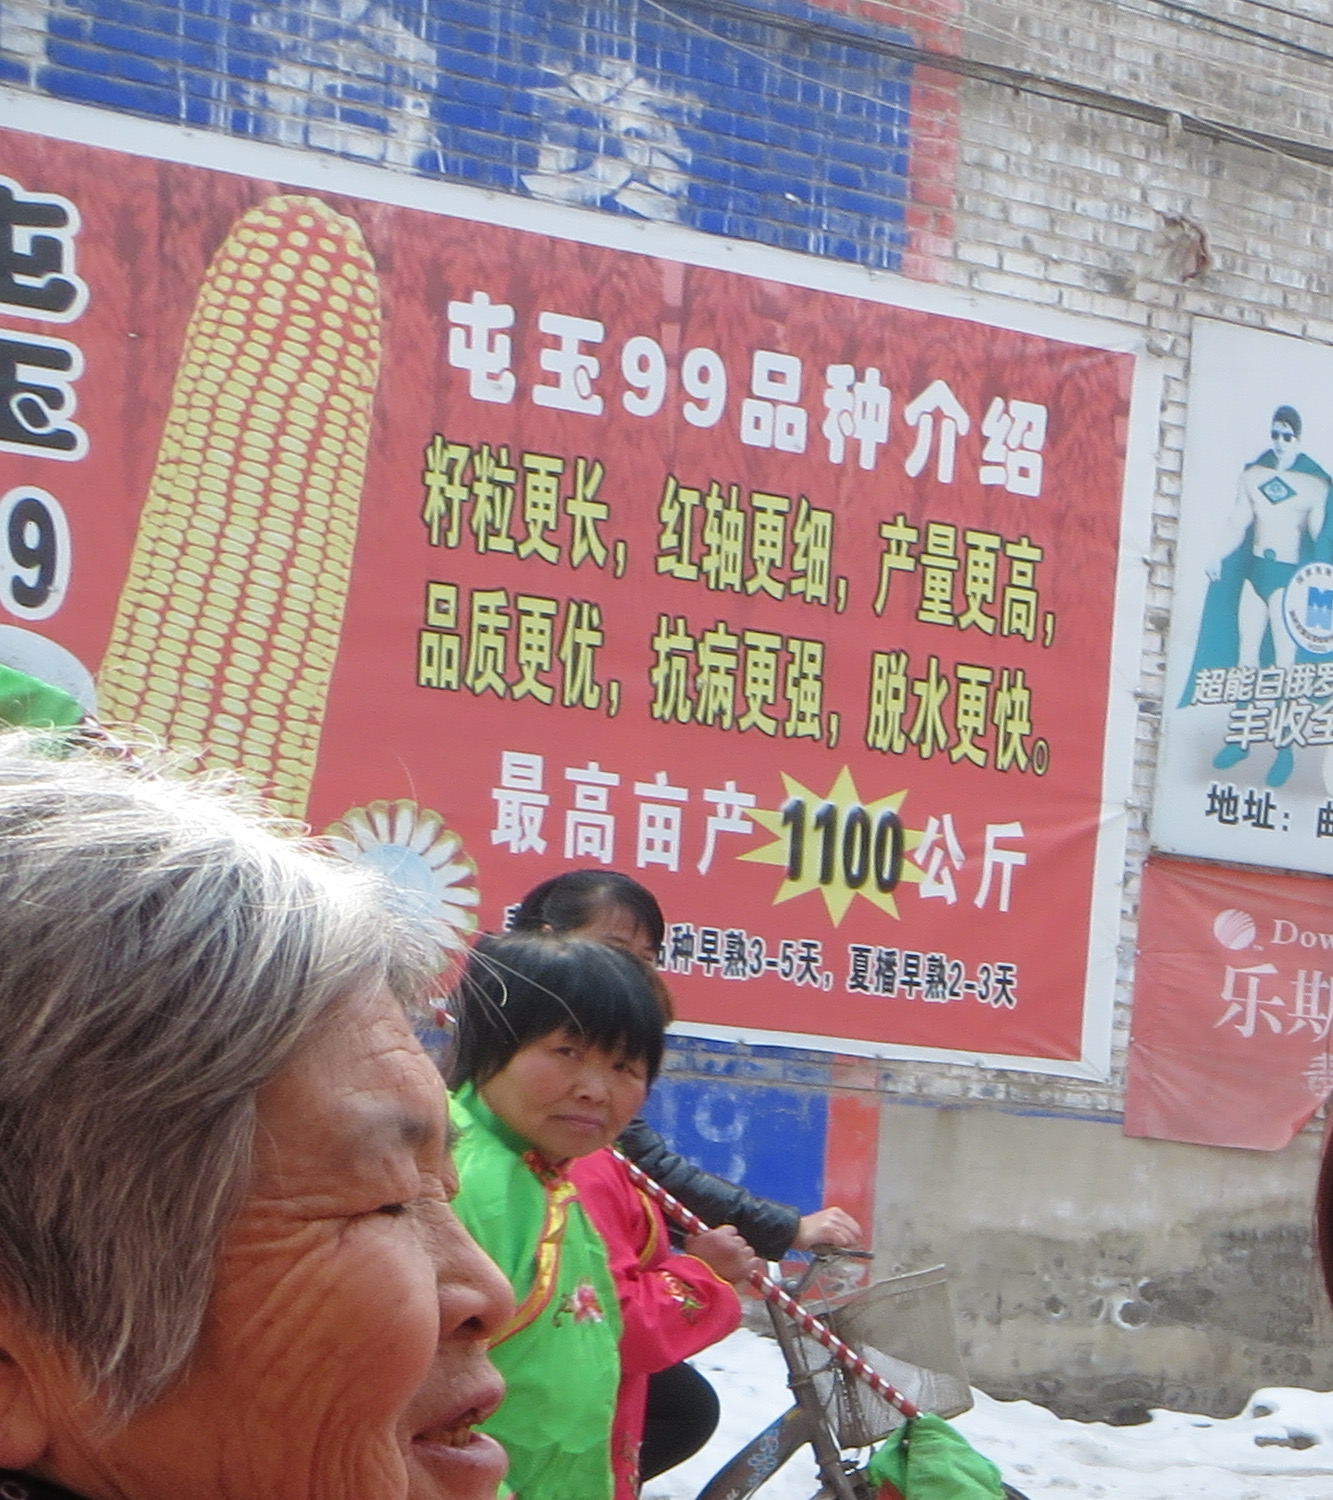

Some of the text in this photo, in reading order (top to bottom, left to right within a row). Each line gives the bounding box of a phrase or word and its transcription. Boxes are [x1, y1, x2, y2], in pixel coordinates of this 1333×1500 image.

[447, 290, 1047, 497] 屯玉99品种介绍
[490, 750, 1028, 912] 最高亩产1100公斤
[1205, 782, 1290, 832] 地址:
